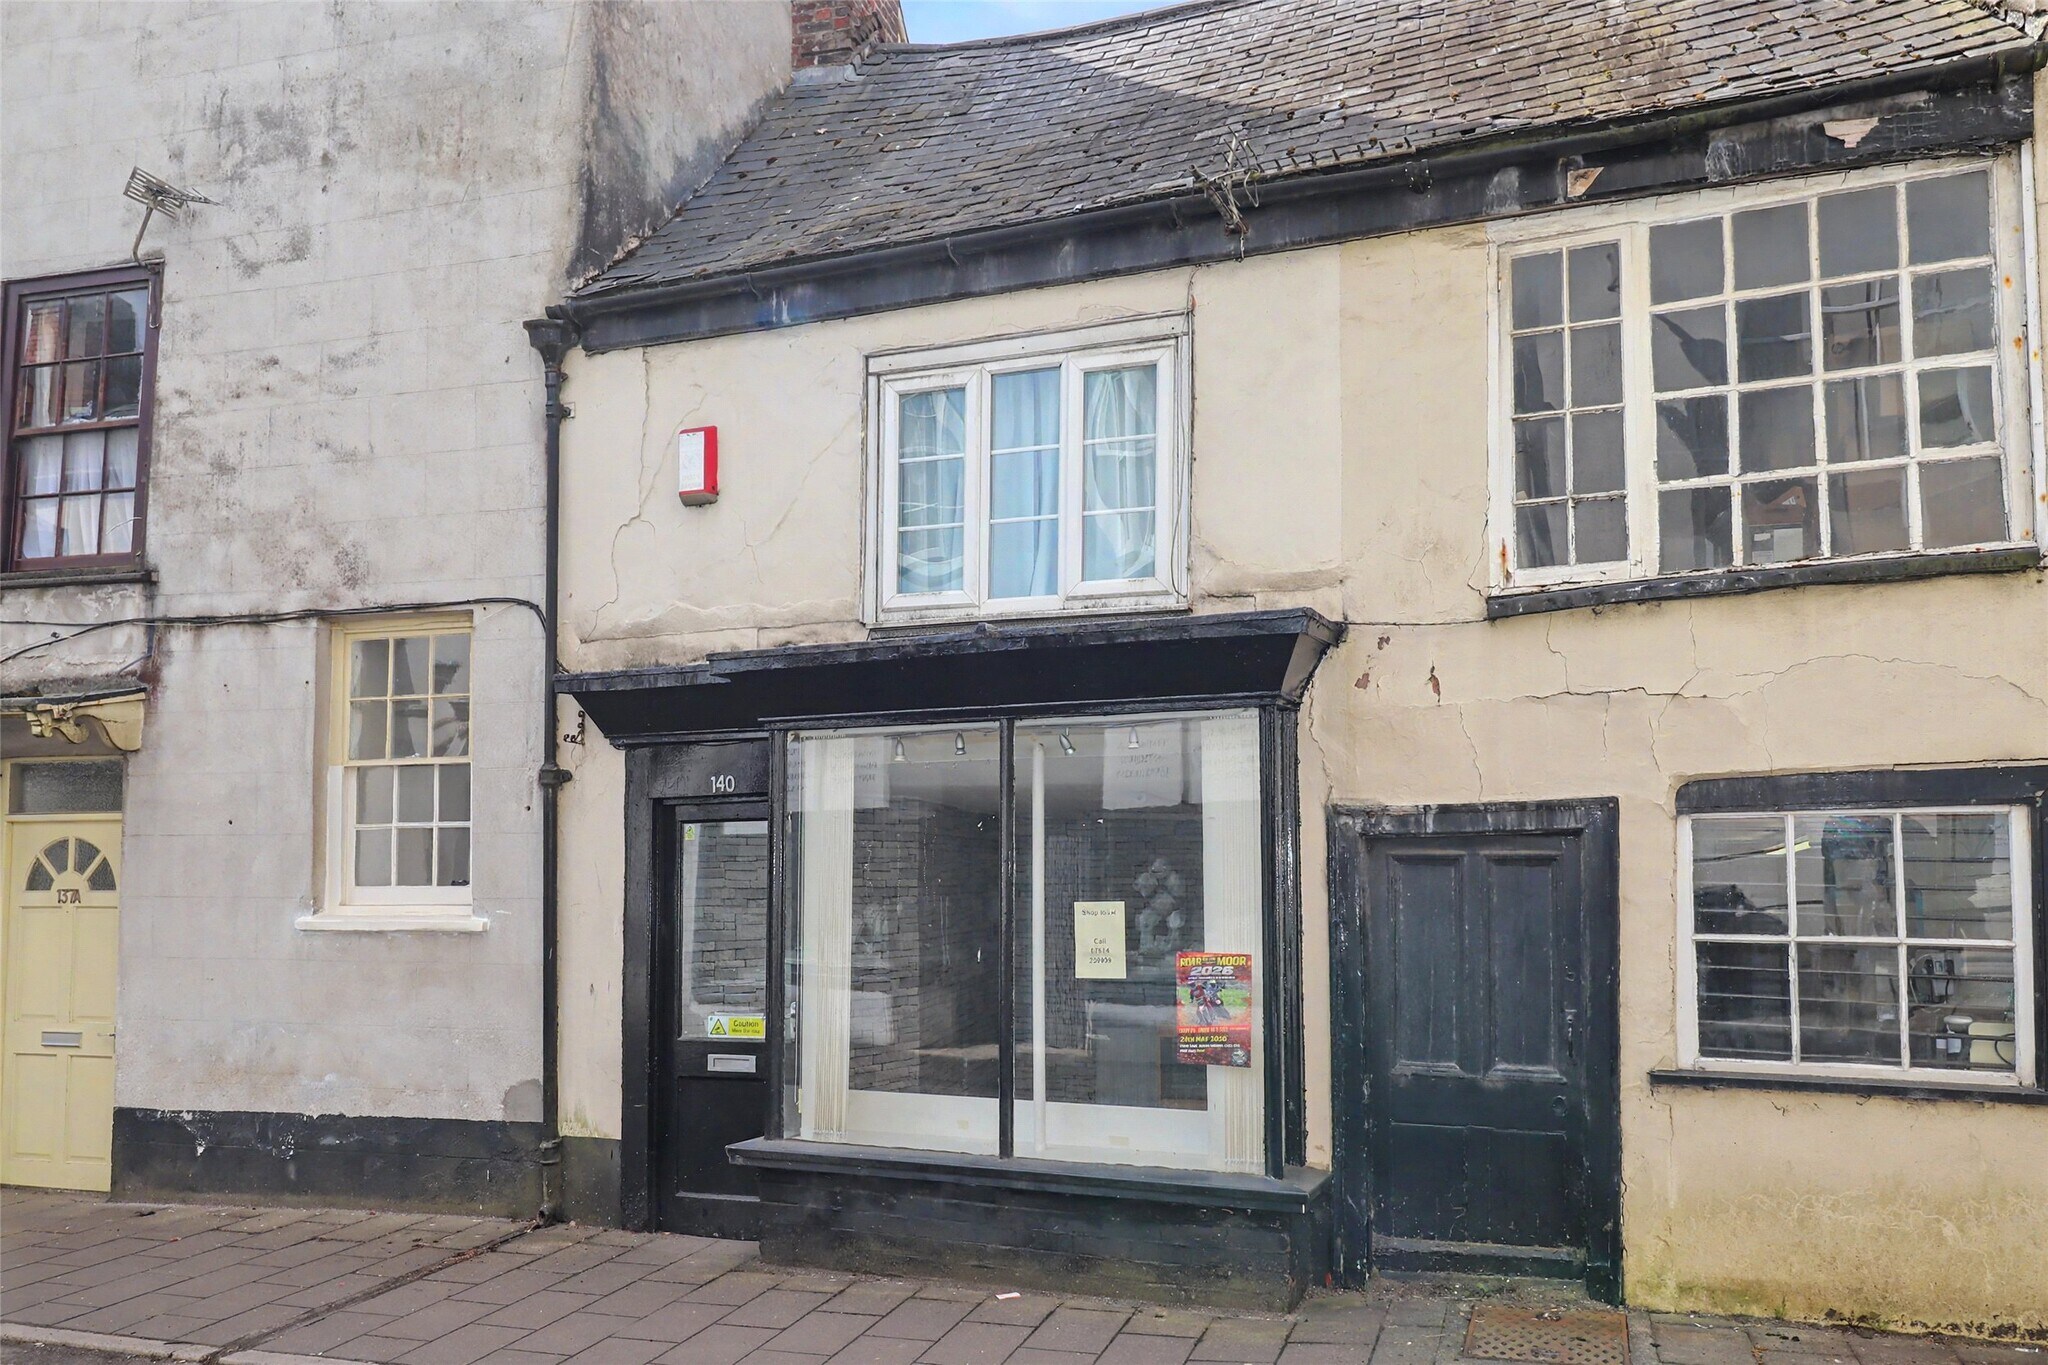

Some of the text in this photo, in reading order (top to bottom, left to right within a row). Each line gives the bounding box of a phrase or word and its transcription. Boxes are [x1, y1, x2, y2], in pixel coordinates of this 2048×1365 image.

[711, 775, 735, 793] 140
[57, 889, 81, 904] 137A
[1180, 957, 1202, 967] ROAR
[1216, 956, 1246, 966] MOOR
[1190, 966, 1234, 976] 2026
